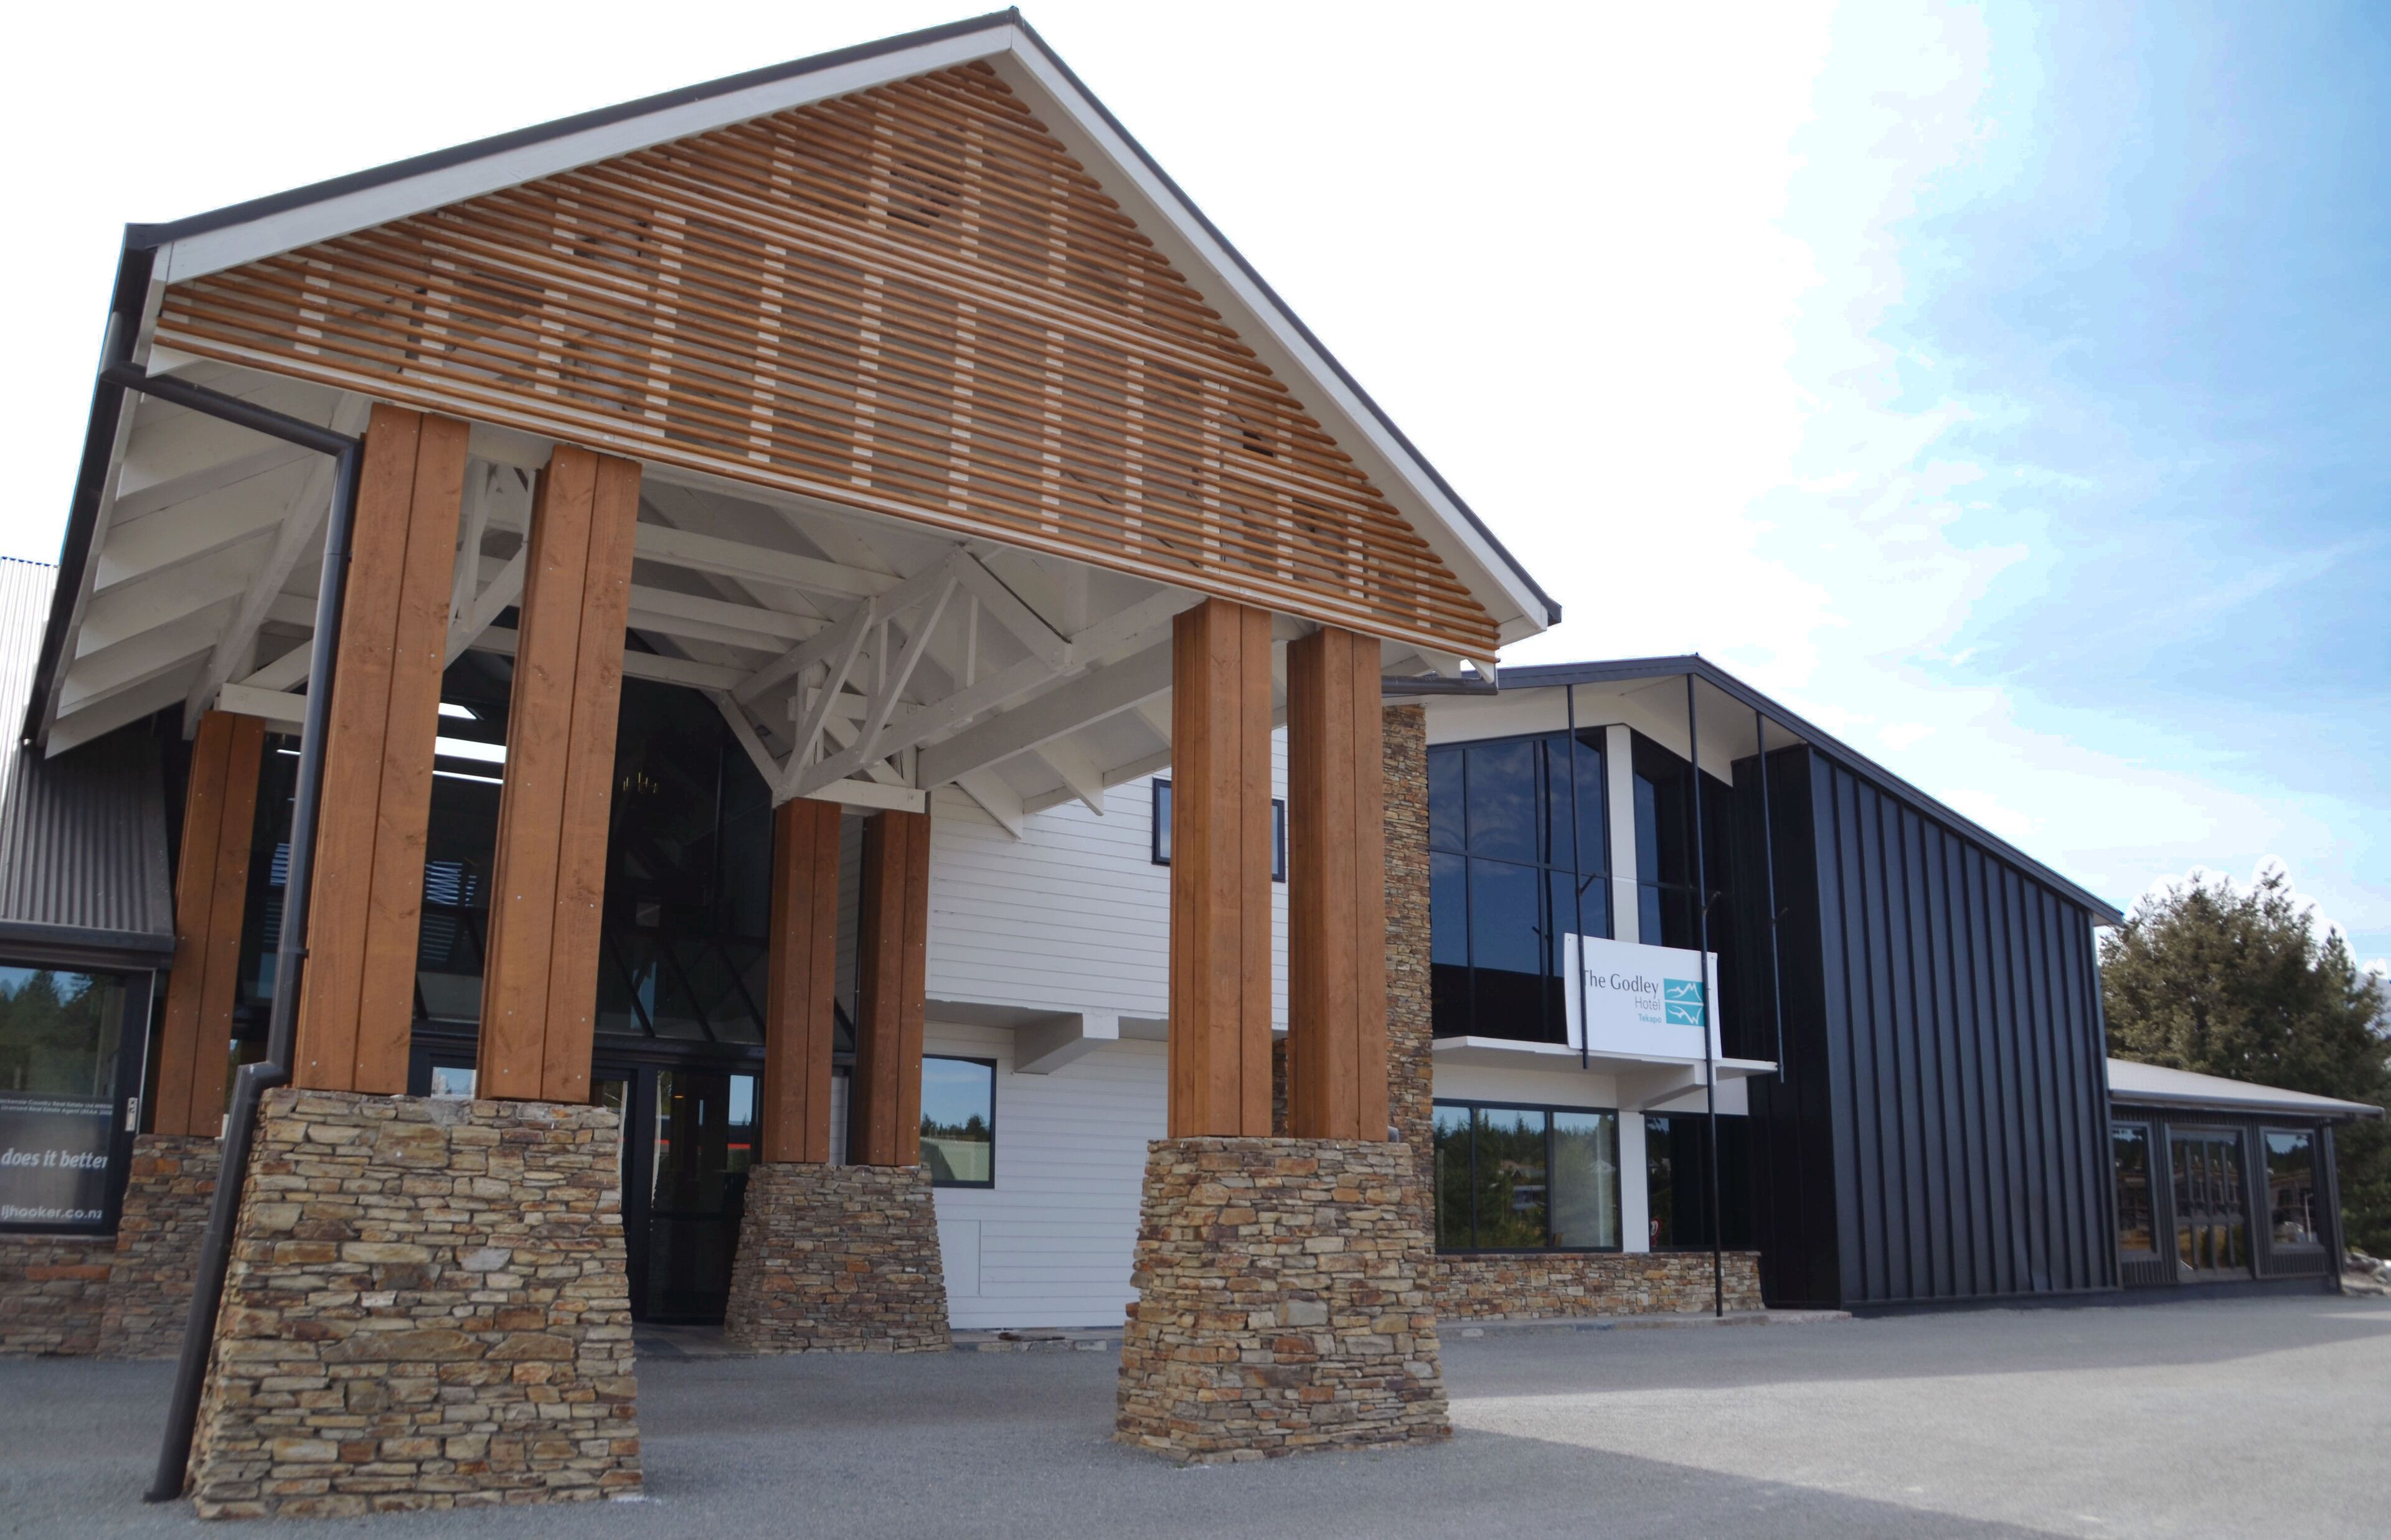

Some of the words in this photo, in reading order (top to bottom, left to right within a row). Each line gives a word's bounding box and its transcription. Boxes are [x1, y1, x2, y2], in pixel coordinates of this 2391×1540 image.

[1610, 973, 1659, 999] Godley
[1635, 996, 1661, 1011] Hotel
[1638, 1013, 1662, 1025] Tekapo
[1, 1147, 40, 1167] does
[43, 1149, 58, 1167] it
[60, 1150, 108, 1169] better
[1, 1204, 103, 1221] ljhooker.co.nz
